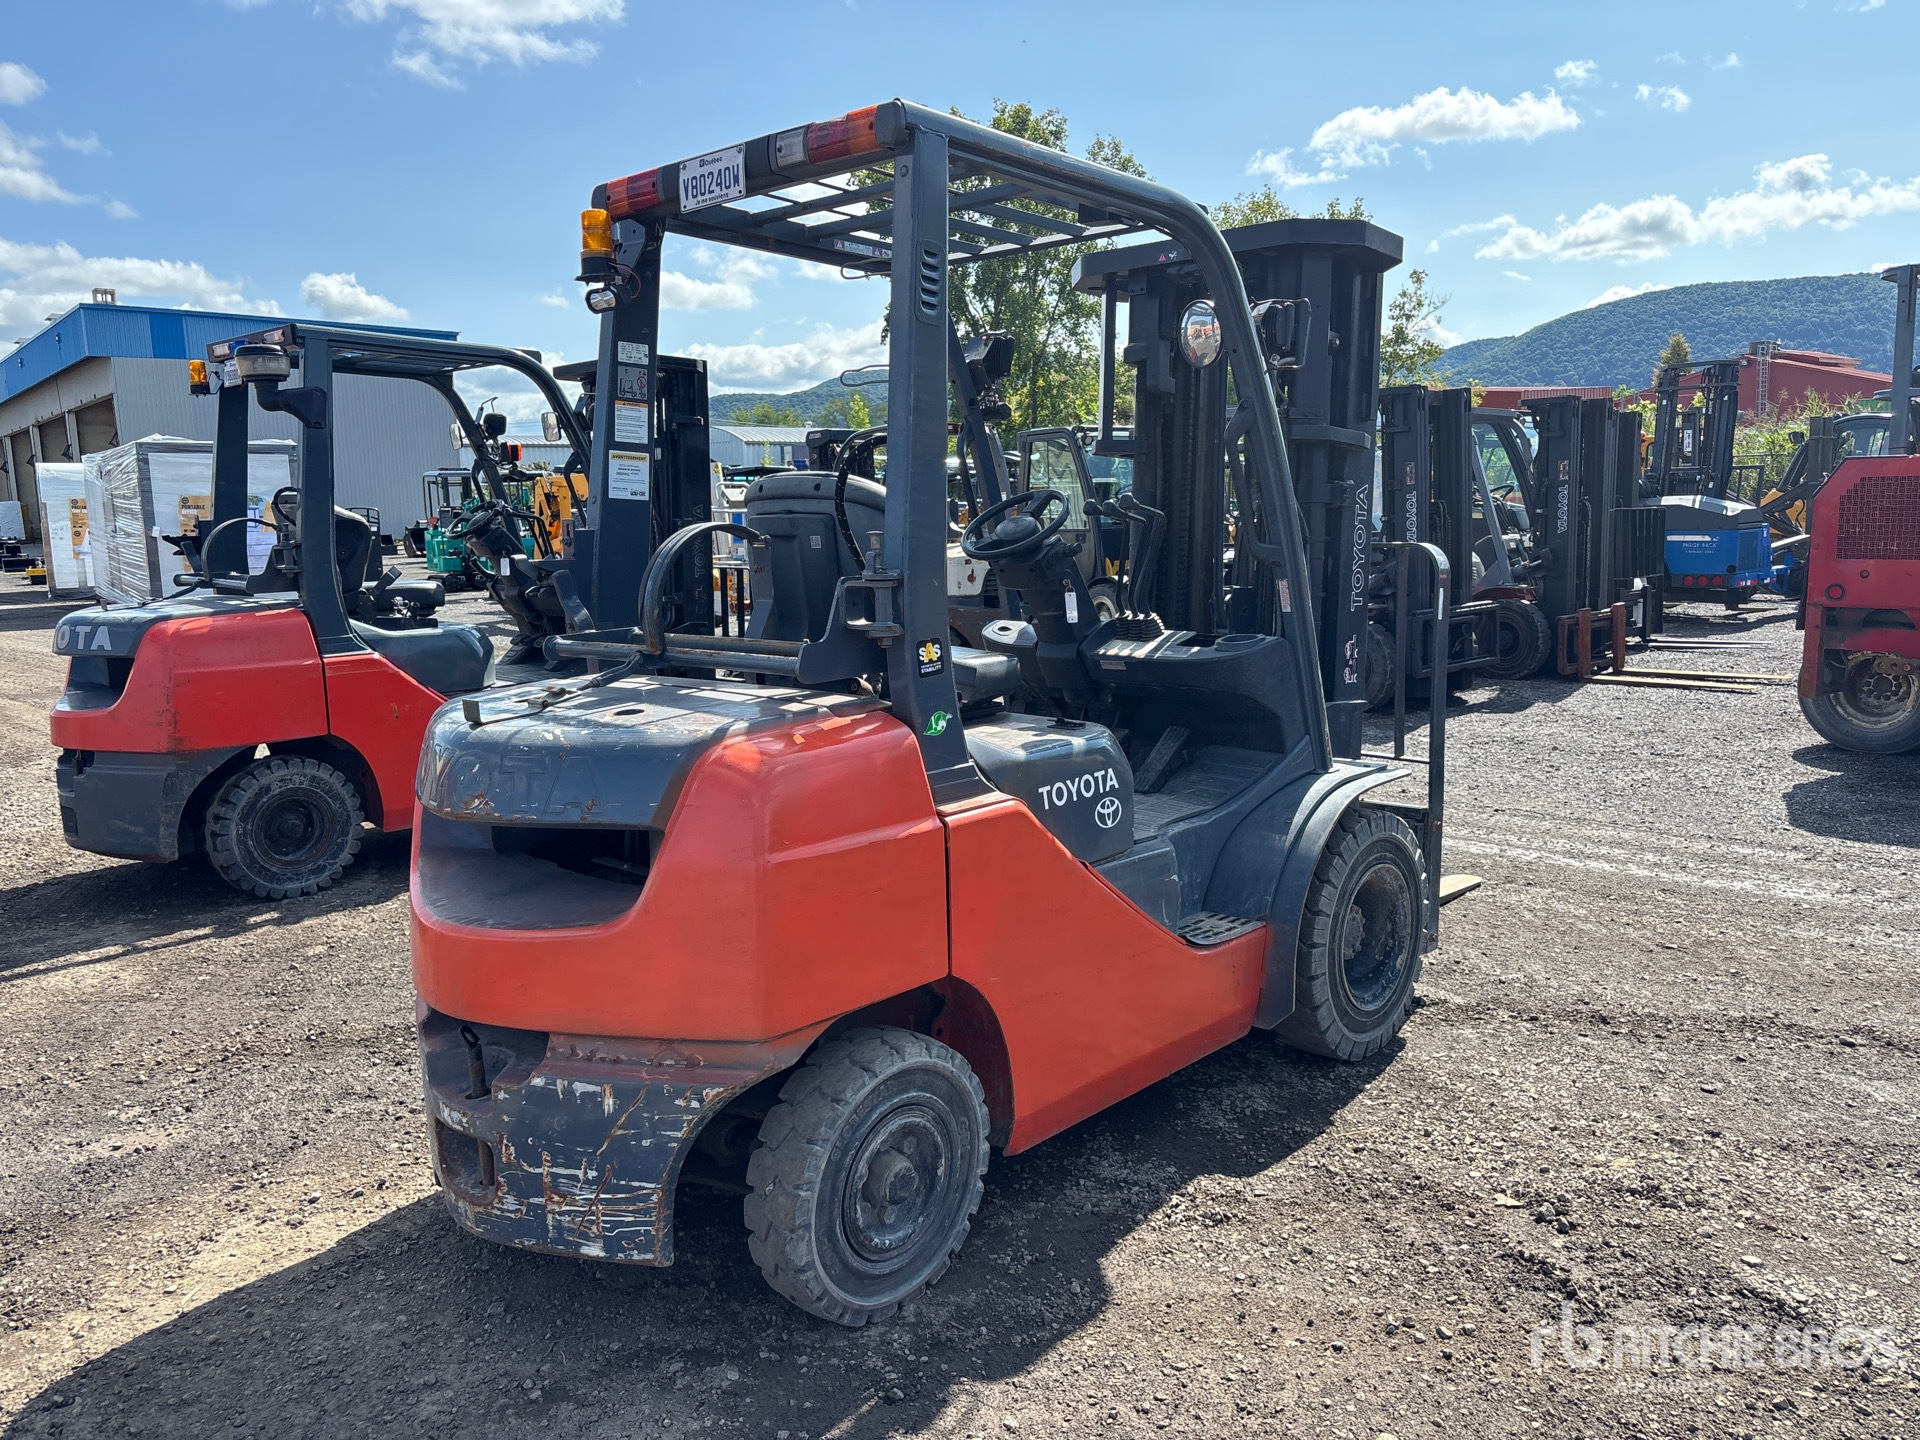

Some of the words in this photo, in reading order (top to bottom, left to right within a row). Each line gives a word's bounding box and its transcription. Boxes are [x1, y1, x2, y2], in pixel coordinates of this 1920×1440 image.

[704, 156, 723, 166] Québec
[682, 163, 740, 201] V80240W
[708, 192, 729, 202] souviens
[1557, 484, 1569, 534] TOYOTA
[1351, 484, 1369, 612] TOYOTA
[918, 642, 942, 664] SAS
[920, 664, 942, 674] STABILITY
[1038, 767, 1120, 811] TOYOTA
